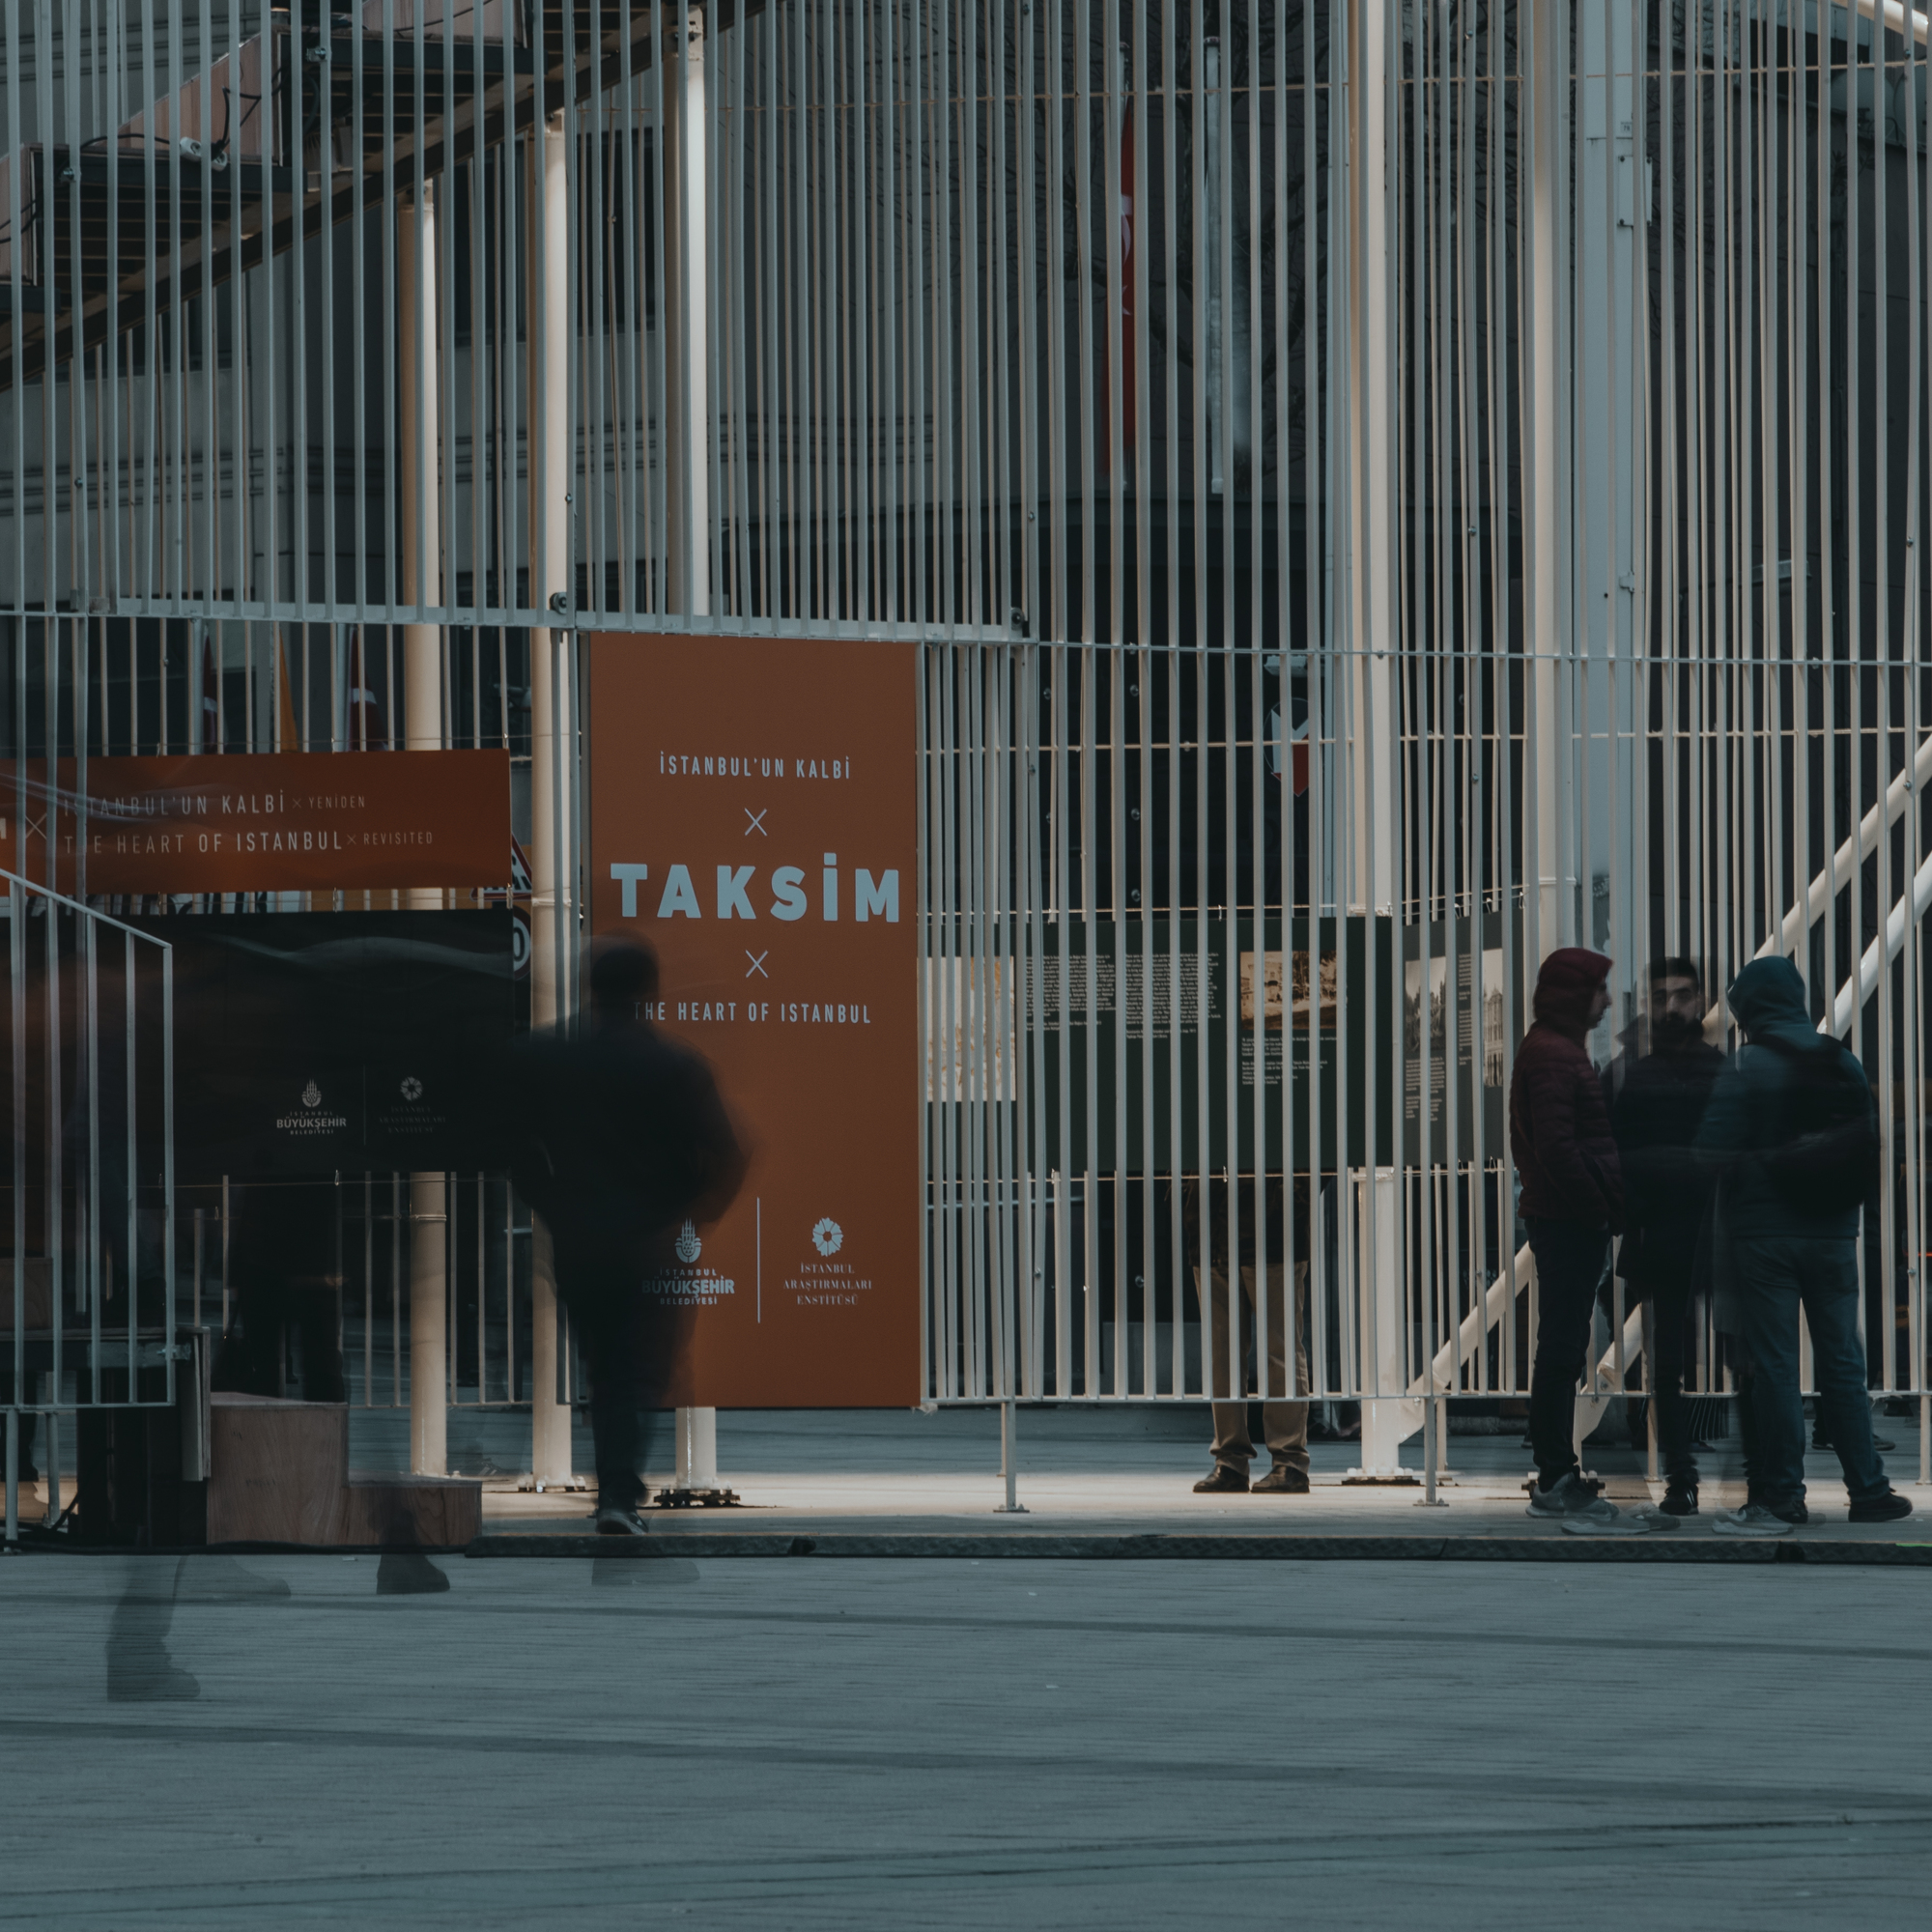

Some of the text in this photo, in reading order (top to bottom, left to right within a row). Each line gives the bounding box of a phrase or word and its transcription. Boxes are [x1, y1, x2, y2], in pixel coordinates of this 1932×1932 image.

[660, 751, 850, 780] İSTANBUL'UN KALBİ
[222, 789, 285, 815] KALBİ
[308, 792, 366, 810] YENİDEN
[64, 835, 102, 854] TE
[117, 834, 185, 854] HEART
[199, 833, 222, 853] OF
[238, 832, 342, 852] ISTANBUL
[363, 831, 434, 846] REVISITED
[611, 852, 899, 923] TAKSİM
[678, 1002, 737, 1022] HEART
[748, 1002, 769, 1022] OF
[781, 1003, 871, 1024] ISTANBUL
[276, 1115, 347, 1130] BÜYÜKŞEHİR
[800, 1262, 855, 1273] İSTANBUL
[641, 1275, 735, 1297] BÜYÜKŞEHİR
[783, 1279, 872, 1292] ARAŞTIRMALARI
